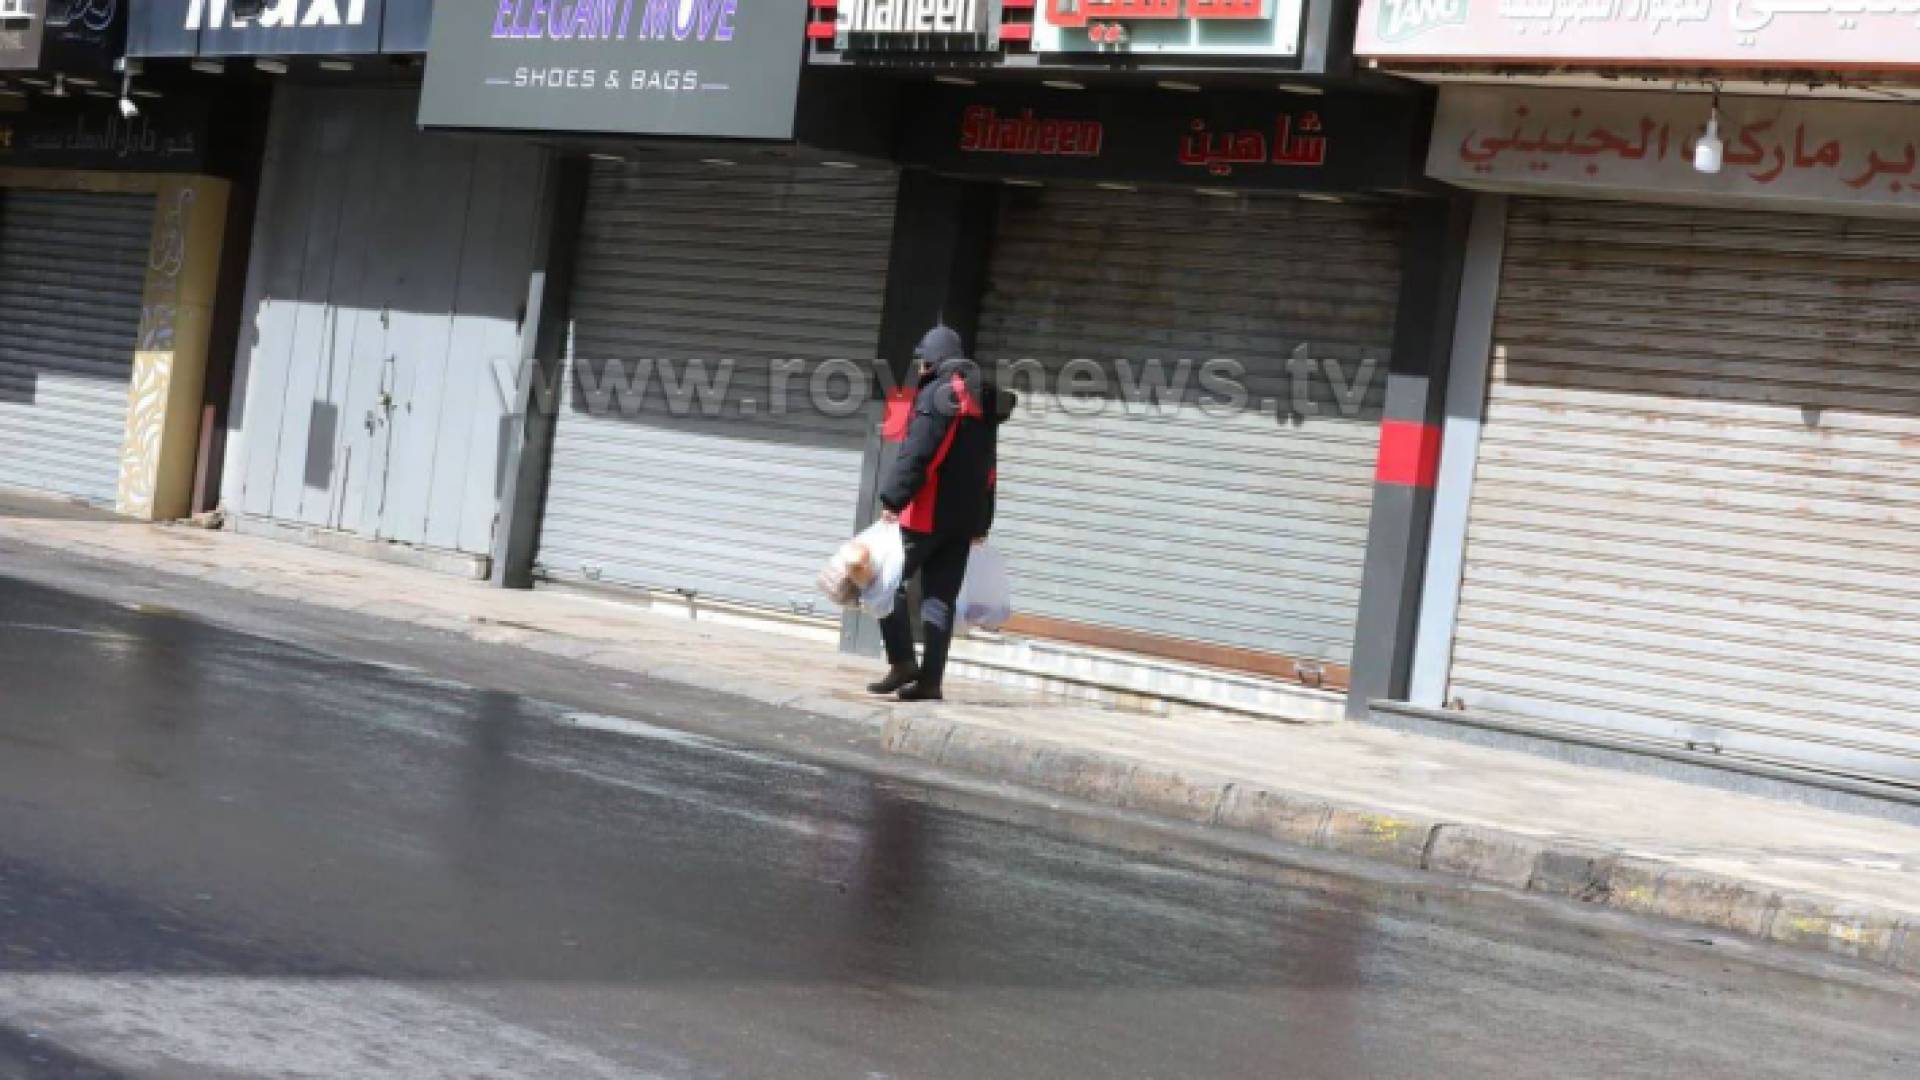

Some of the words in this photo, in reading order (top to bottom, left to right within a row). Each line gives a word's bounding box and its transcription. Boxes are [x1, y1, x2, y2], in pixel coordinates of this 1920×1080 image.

[491, 0, 632, 40] ELEGANT
[639, 0, 737, 42] MOVE
[513, 66, 596, 88] SHOES
[604, 69, 620, 89] &
[631, 69, 698, 91] BAGS
[960, 104, 1102, 157] Shaheen
[1177, 111, 1327, 176] شاهين
[1460, 104, 1670, 174] الجنيني
